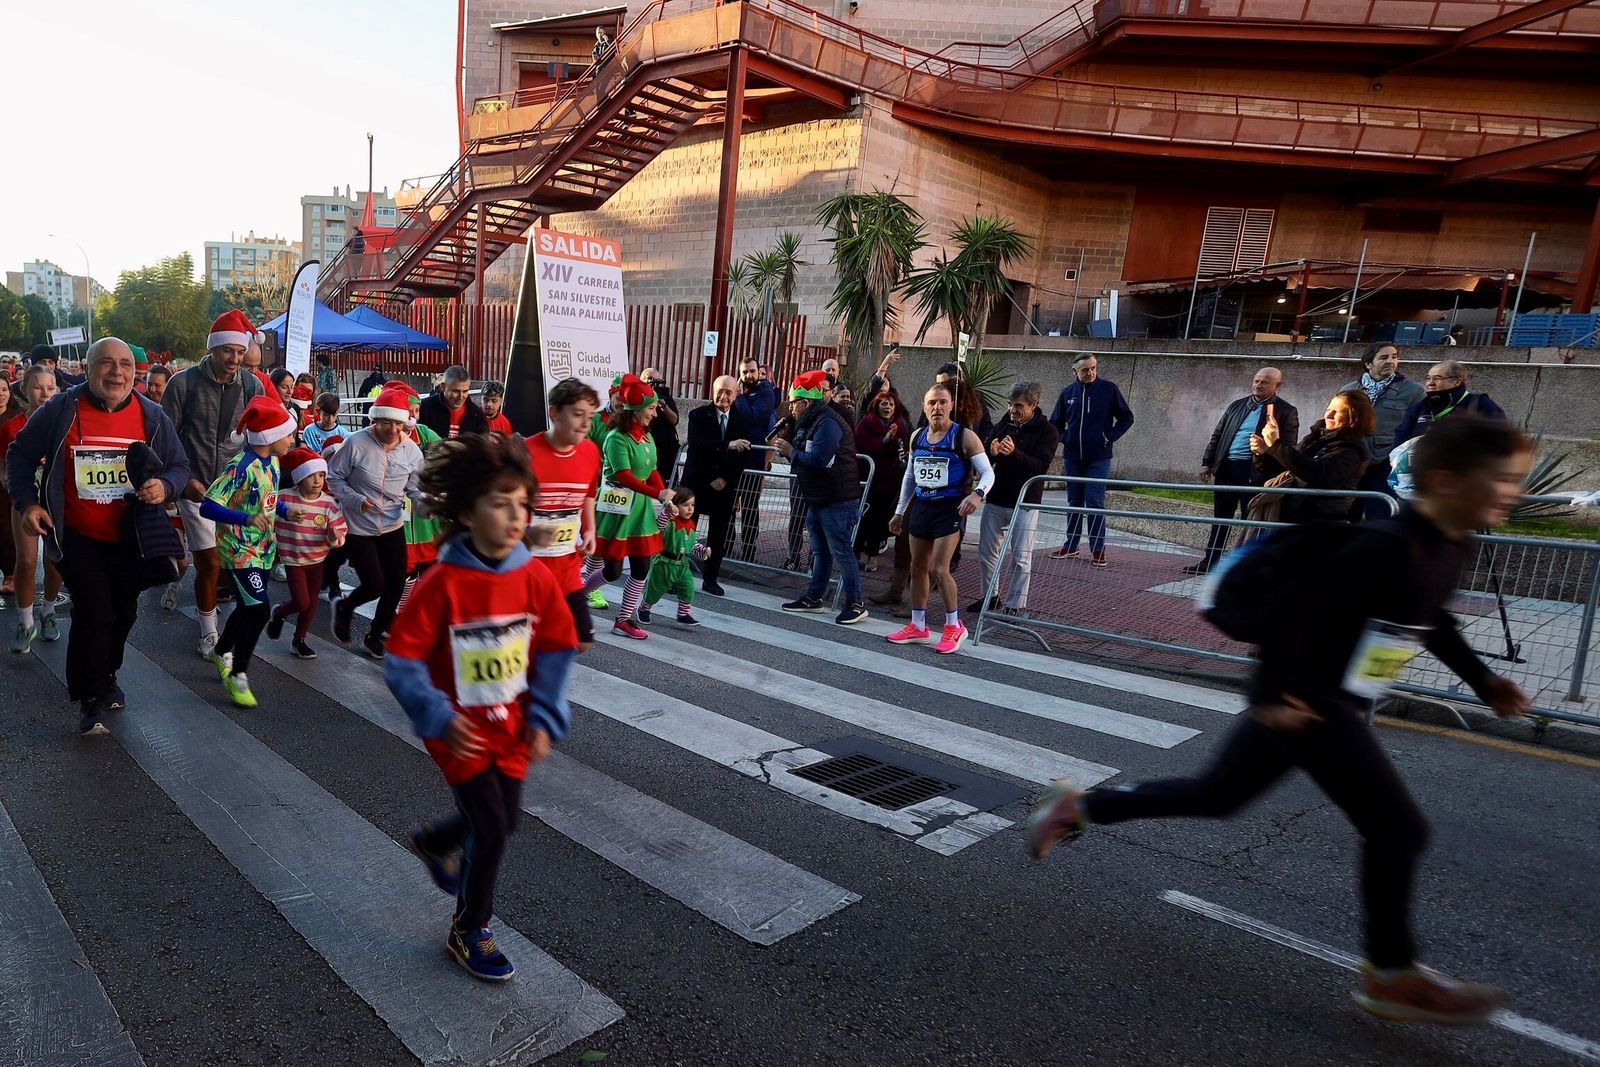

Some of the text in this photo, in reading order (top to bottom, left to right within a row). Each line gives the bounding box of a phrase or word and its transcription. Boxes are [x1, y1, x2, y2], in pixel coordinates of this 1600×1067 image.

[540, 233, 617, 263] SALIDA
[541, 262, 620, 290] XIV CARRERA
[548, 289, 617, 307] SAN SILVESTRE
[543, 303, 624, 322] PALMA PALMILLA
[577, 351, 611, 364] Ciudad
[578, 366, 590, 377] de
[86, 470, 128, 485] 1016
[919, 468, 942, 480] 954
[602, 493, 627, 506] 1009
